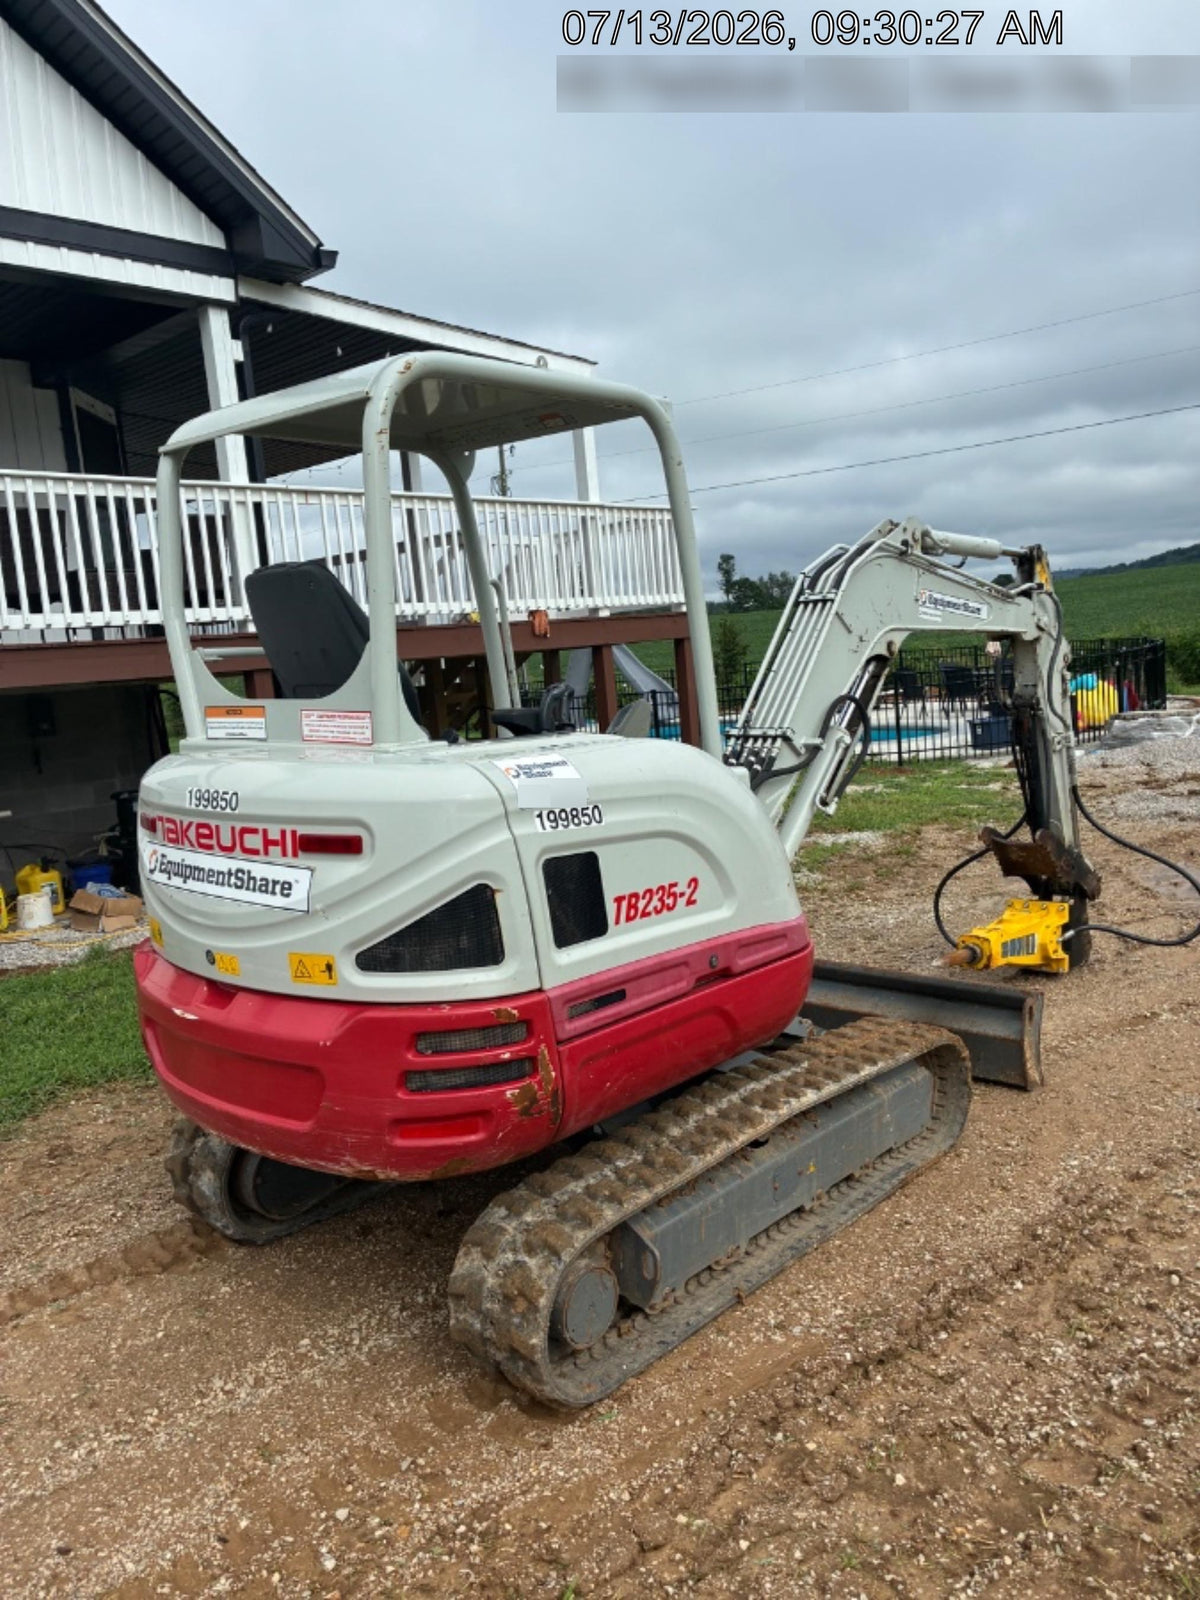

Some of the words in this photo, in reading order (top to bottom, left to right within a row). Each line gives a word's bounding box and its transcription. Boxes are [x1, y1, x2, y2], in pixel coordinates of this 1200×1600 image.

[186, 788, 240, 812] 199850
[535, 804, 604, 831] 199850
[158, 853, 293, 898] EquipmentShare
[612, 877, 700, 926] TB235-2
